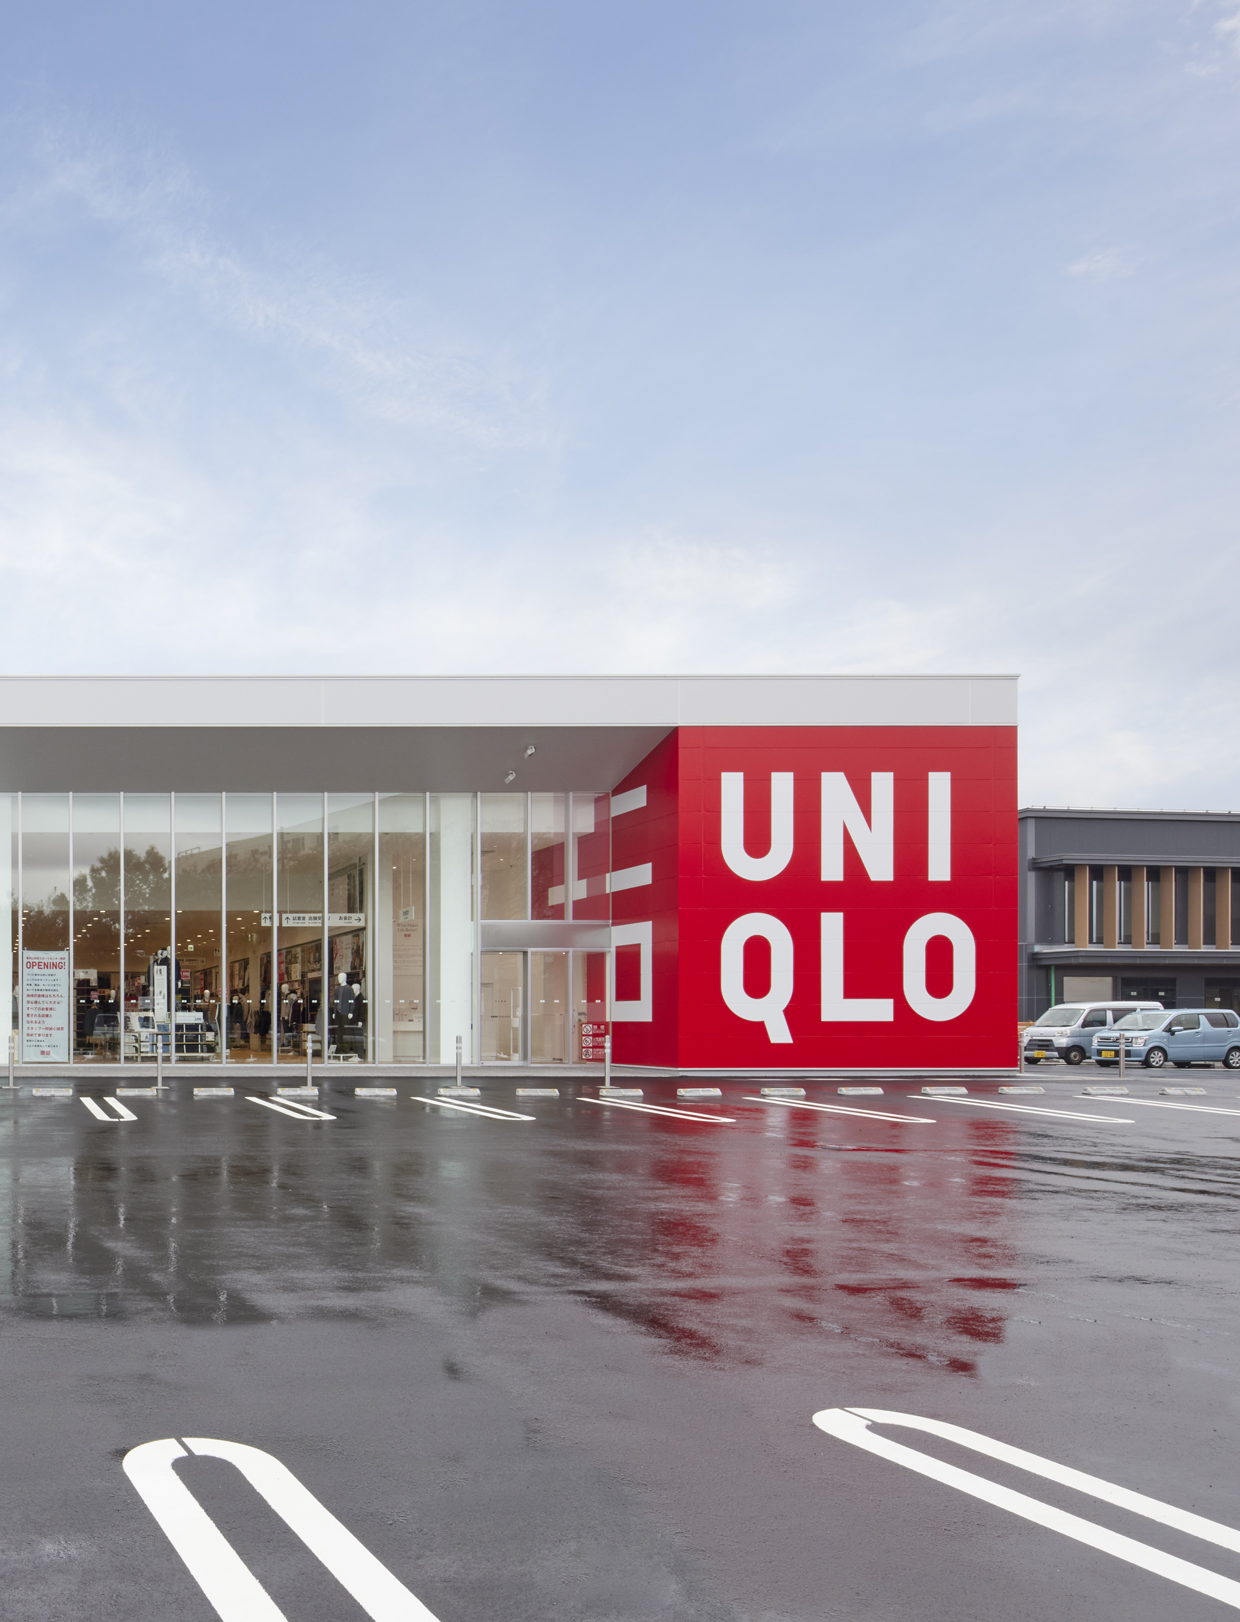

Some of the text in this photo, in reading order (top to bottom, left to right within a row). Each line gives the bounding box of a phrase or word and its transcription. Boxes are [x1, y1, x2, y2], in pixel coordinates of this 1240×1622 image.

[720, 771, 951, 882] UNI
[26, 961, 65, 970] OPENING!
[720, 912, 977, 1044] QLO
